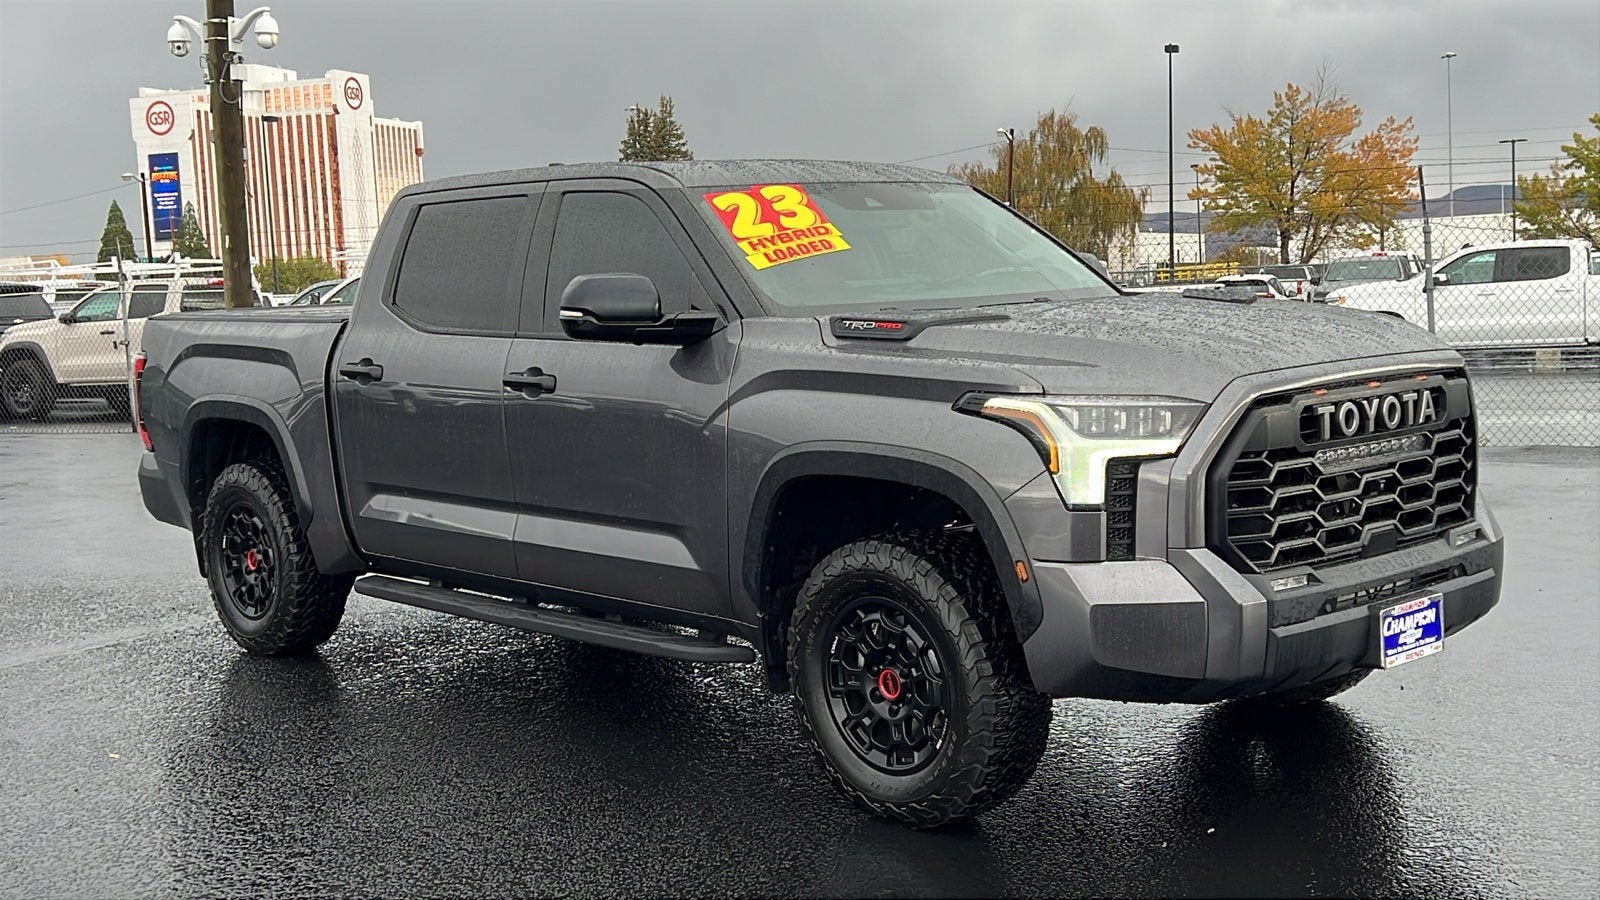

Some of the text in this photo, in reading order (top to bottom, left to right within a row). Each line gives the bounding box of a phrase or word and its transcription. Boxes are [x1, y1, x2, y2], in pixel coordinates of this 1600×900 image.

[346, 86, 361, 102] GSR
[149, 112, 171, 126] GSR
[712, 184, 822, 239] 23
[747, 225, 832, 252] HYBRID
[763, 239, 835, 264] LOADED
[842, 320, 903, 330] TRD PRO
[1316, 390, 1437, 441] TOYOTA
[1396, 599, 1426, 614] CHAMPION
[1383, 607, 1437, 637] CHAMPION
[1405, 649, 1425, 661] RENO
